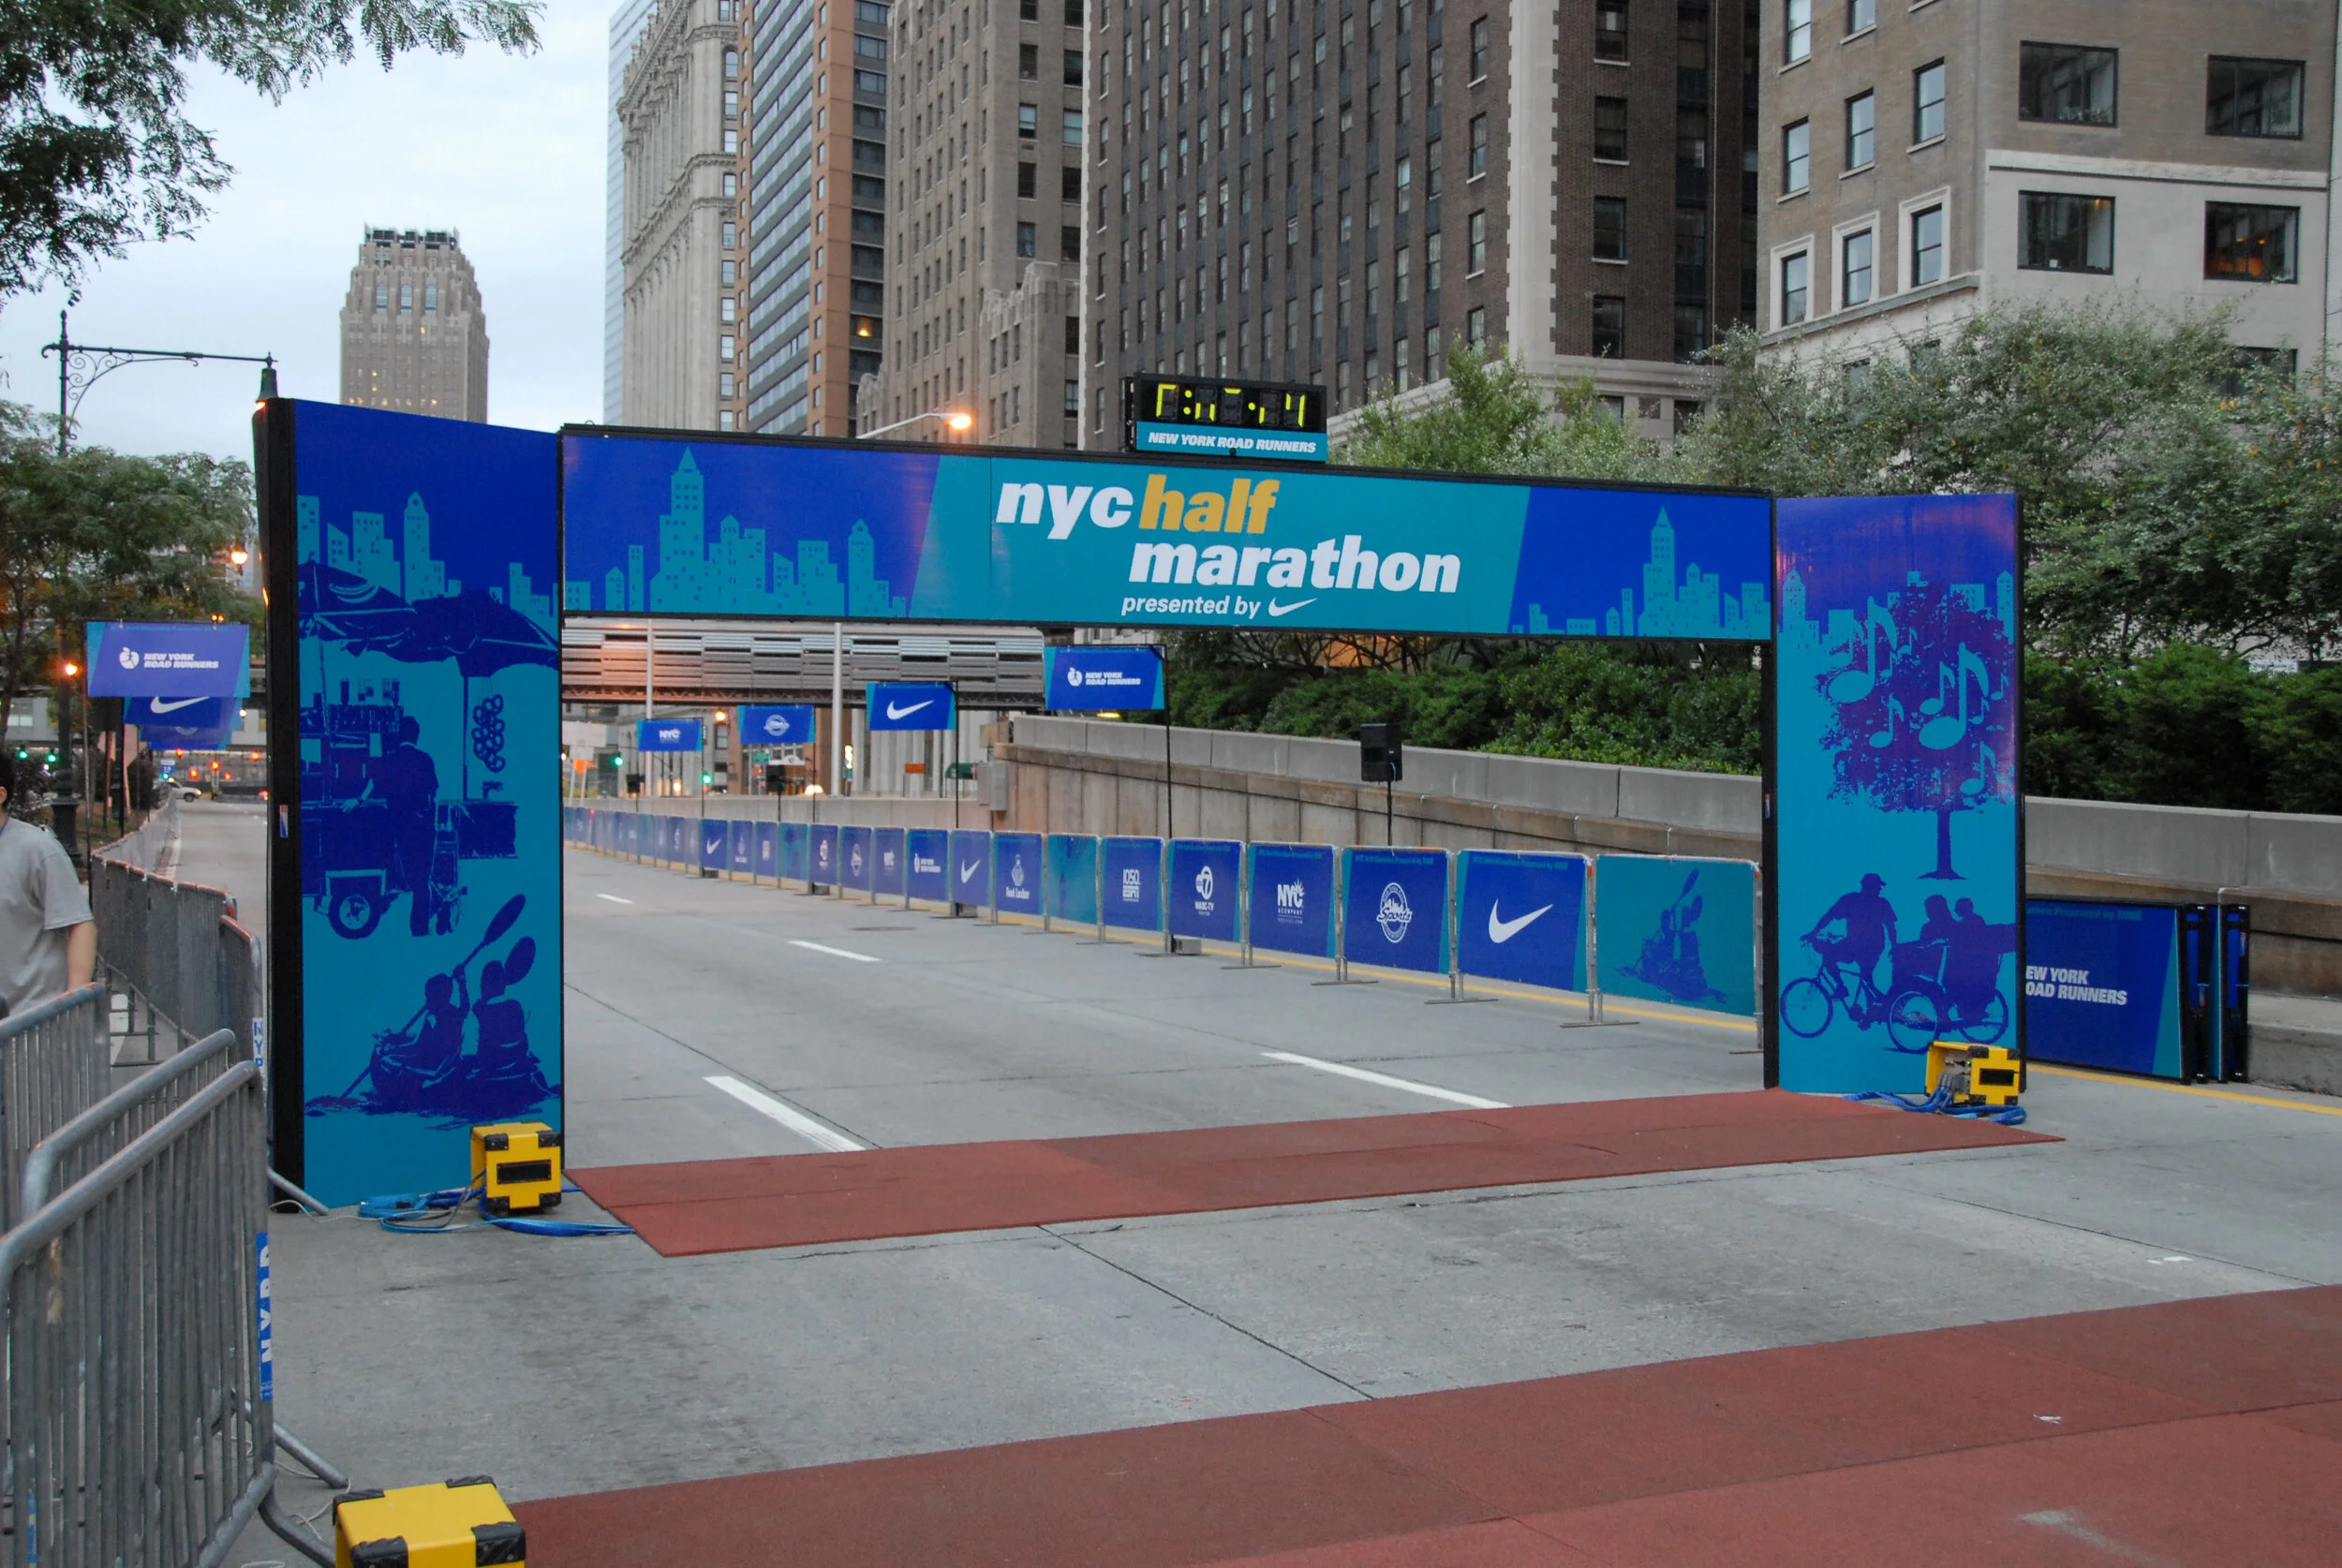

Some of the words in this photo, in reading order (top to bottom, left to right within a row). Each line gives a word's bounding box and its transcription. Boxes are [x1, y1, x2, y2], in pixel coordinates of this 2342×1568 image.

[1149, 432, 1179, 445] NEW
[1181, 434, 1217, 448] YORK
[1217, 436, 1254, 450] ROAD
[1255, 440, 1317, 453] RUNNERS
[996, 482, 1134, 540] nyc
[1138, 474, 1281, 534] half
[1129, 535, 1460, 593] marathon
[1121, 595, 1231, 616] presented
[1234, 596, 1261, 619] by
[143, 660, 172, 669] ROAD
[168, 653, 195, 661] YORK
[1278, 883, 1303, 908] NYC
[1377, 907, 1412, 923] Sports
[2025, 966, 2048, 981] EW
[2050, 968, 2090, 984] YORK
[2025, 982, 2055, 998] OAD
[2057, 984, 2127, 1006] RUNNERS
